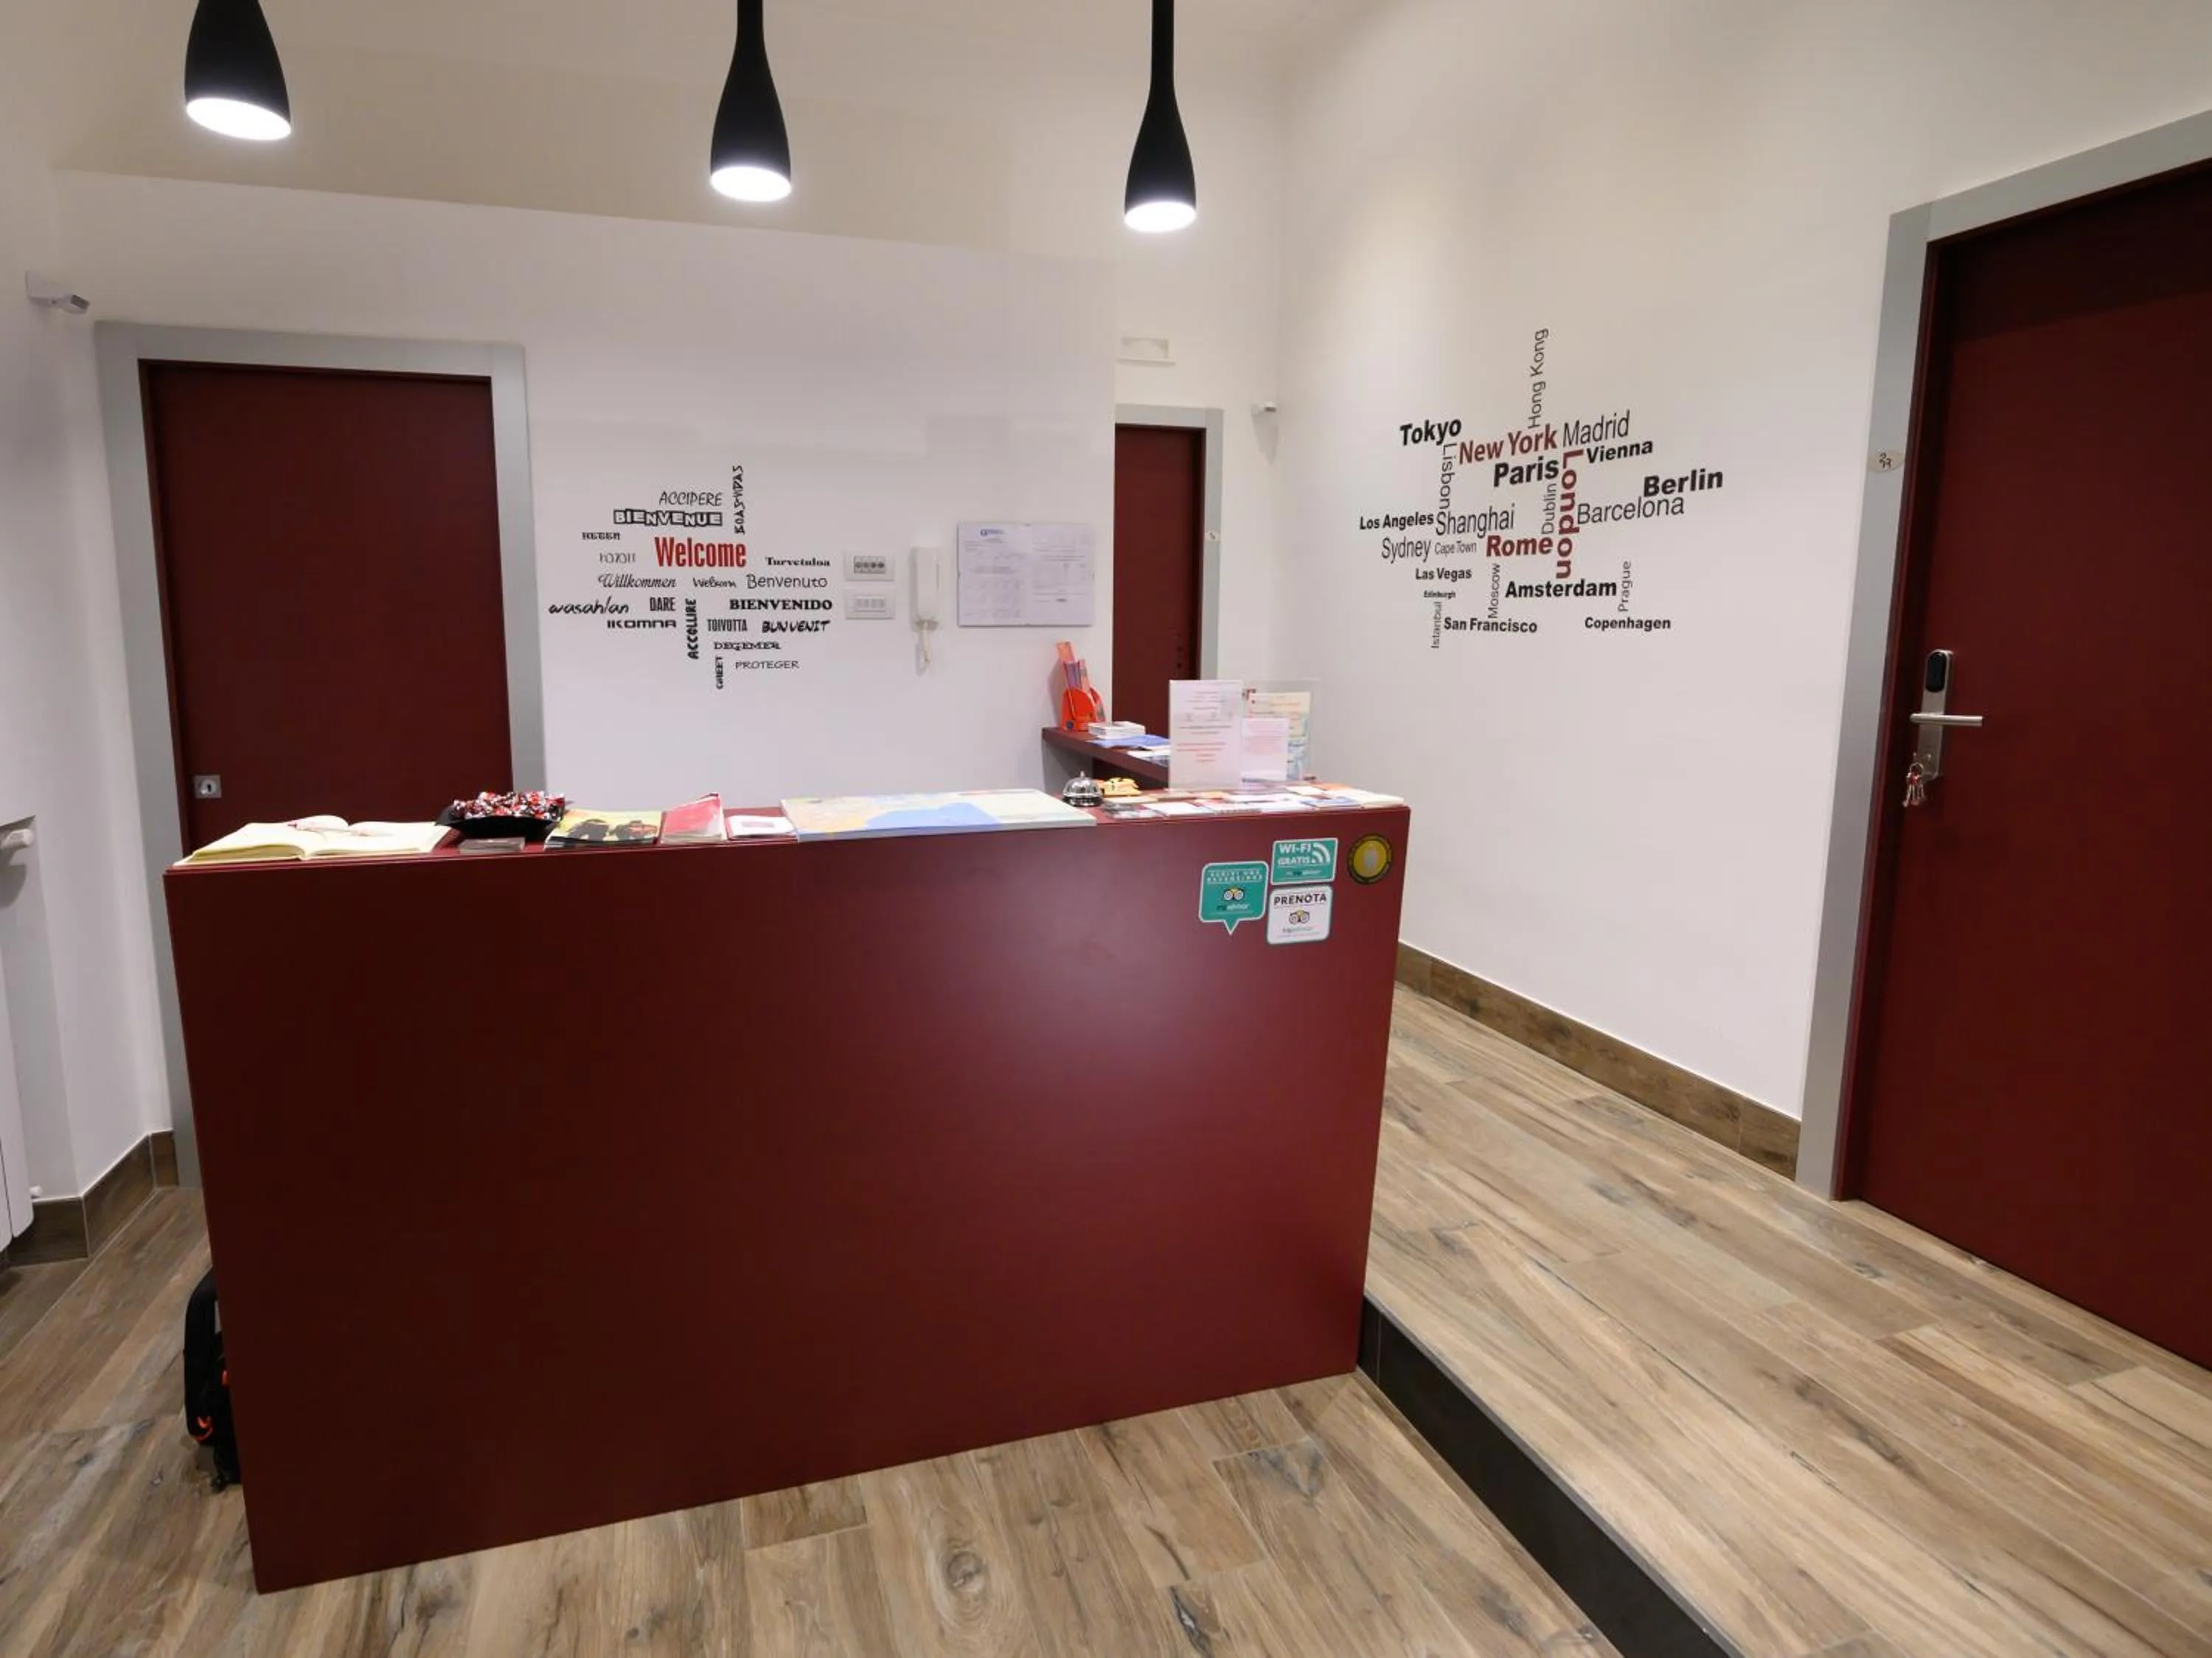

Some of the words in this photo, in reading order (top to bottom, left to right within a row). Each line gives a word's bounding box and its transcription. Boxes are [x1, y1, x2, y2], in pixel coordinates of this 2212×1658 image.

[1531, 328, 1548, 377] Kong
[1528, 381, 1545, 429] Hong
[1399, 418, 1462, 446] Tokyo
[1563, 409, 1630, 447] Madrid
[1458, 440, 1504, 465] New
[1507, 423, 1558, 457] York
[1586, 440, 1654, 464] Vienna
[1439, 443, 1458, 510] Lisbon
[1493, 457, 1559, 488] Paris
[1643, 468, 1724, 498] Berlin
[658, 490, 723, 507] ACCIPERE
[1541, 482, 1557, 535] Dublin
[1577, 496, 1685, 524] Barcelona
[613, 507, 723, 527] BIENVENUE
[1360, 515, 1380, 530] Los
[1382, 511, 1435, 532] Angeles
[1436, 503, 1515, 539] Shanghai
[1556, 449, 1585, 579] London
[654, 536, 747, 567] Welcome
[1381, 537, 1431, 564] Sydney
[1434, 542, 1455, 558] Cape
[1456, 541, 1476, 555] Town
[1486, 535, 1554, 558] Rome
[597, 573, 676, 588] Willkommen
[746, 573, 829, 589] Benvenuto
[1415, 568, 1434, 580] Las
[1436, 566, 1472, 583] Vegas
[1618, 561, 1632, 612] Prague
[1423, 590, 1456, 600] Edinburgh
[1488, 563, 1501, 619] Moscow
[1505, 579, 1618, 599] Amsterdam
[649, 597, 676, 611] DARE
[729, 598, 833, 610] BIENVENIDO
[1444, 617, 1467, 631] San
[1470, 617, 1538, 634] Francisco
[1584, 617, 1672, 632] Copenhagen
[1273, 893, 1327, 906] PRENOTA
